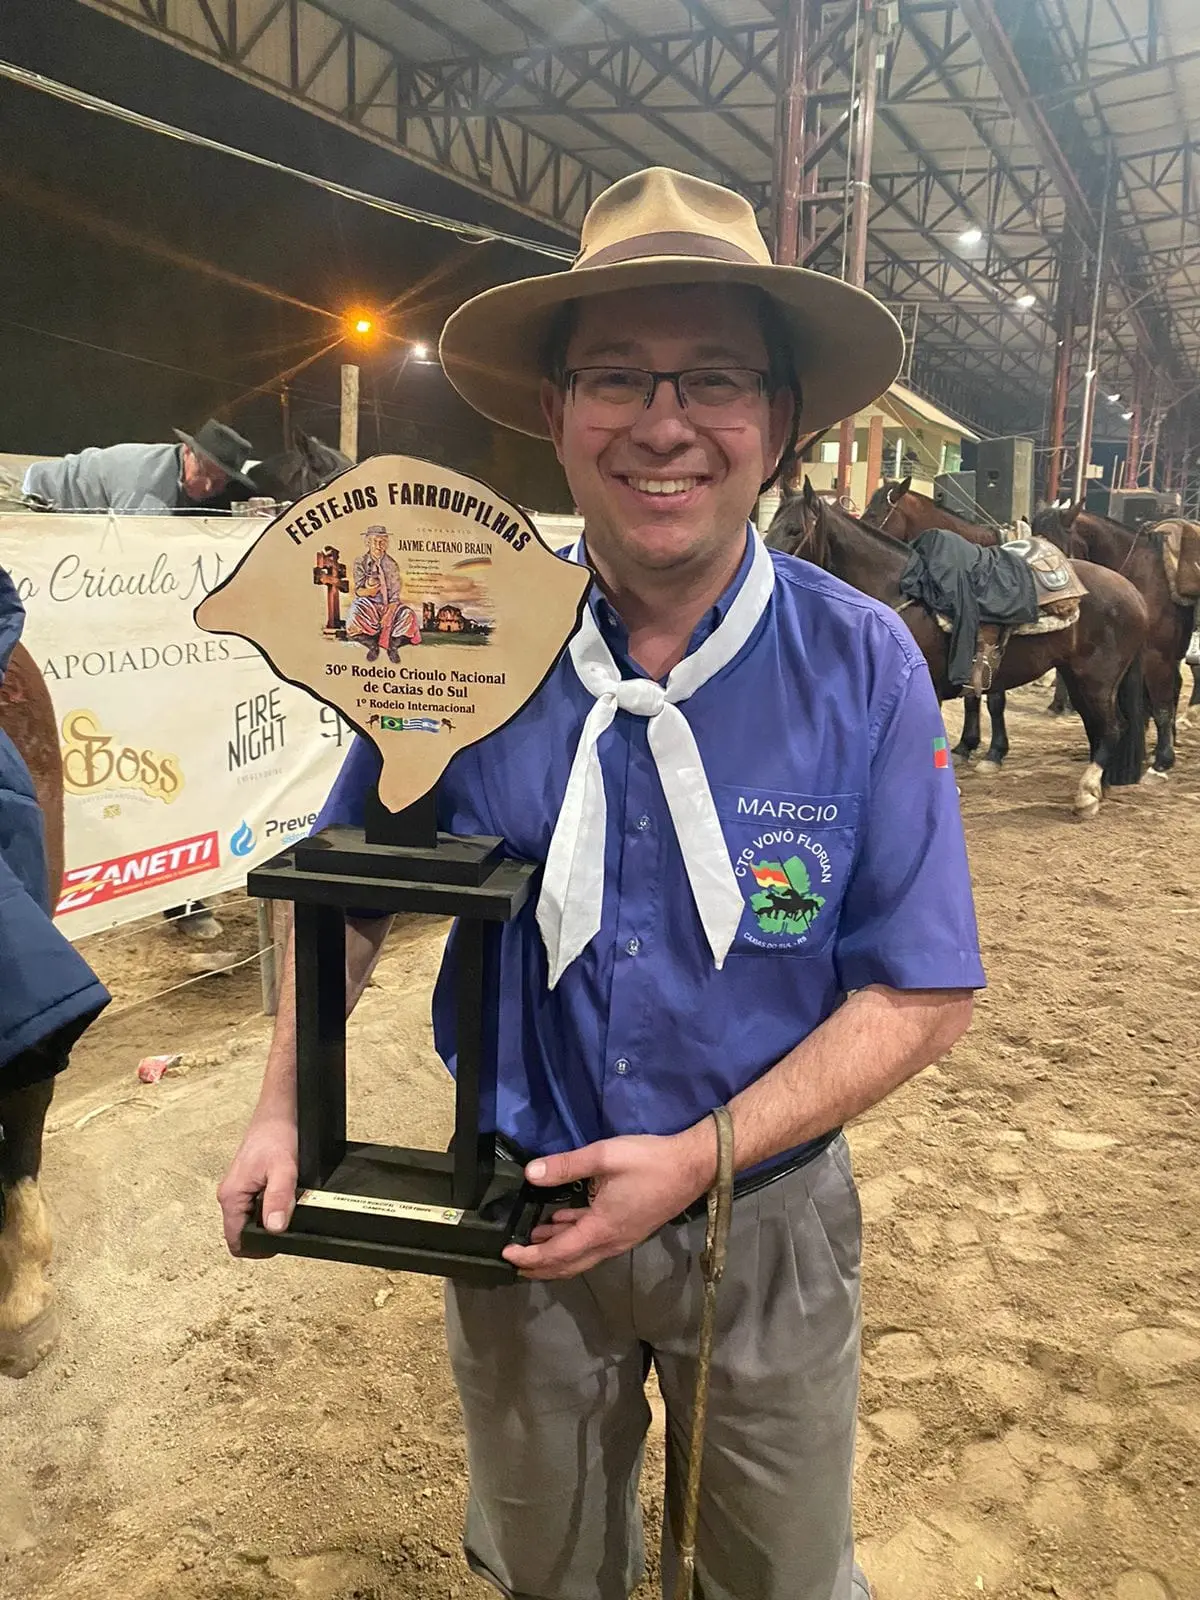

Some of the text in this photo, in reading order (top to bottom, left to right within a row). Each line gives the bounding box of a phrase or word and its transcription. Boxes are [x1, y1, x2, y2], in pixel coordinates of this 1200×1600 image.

[285, 482, 532, 552] FESTEJOS FARROUPILHAS
[398, 539, 493, 555] JAYME CAETANO BRAUN
[49, 552, 180, 602] Crioulo
[43, 639, 230, 680] APOIADORES
[352, 665, 396, 679] Rodeio
[400, 668, 447, 682] Crioulo
[450, 671, 506, 685] Nacional
[236, 687, 282, 730] FIRE
[363, 681, 468, 698] de Caxias do Sul
[369, 699, 405, 711] Rodeio
[407, 702, 476, 714] Internacional
[228, 715, 287, 772] NIGHT
[265, 812, 320, 838] Preve
[737, 797, 838, 822] MARCIO
[55, 838, 213, 912] ZANETTI
[735, 828, 833, 884] CTG VOVÔ FLORIAN
